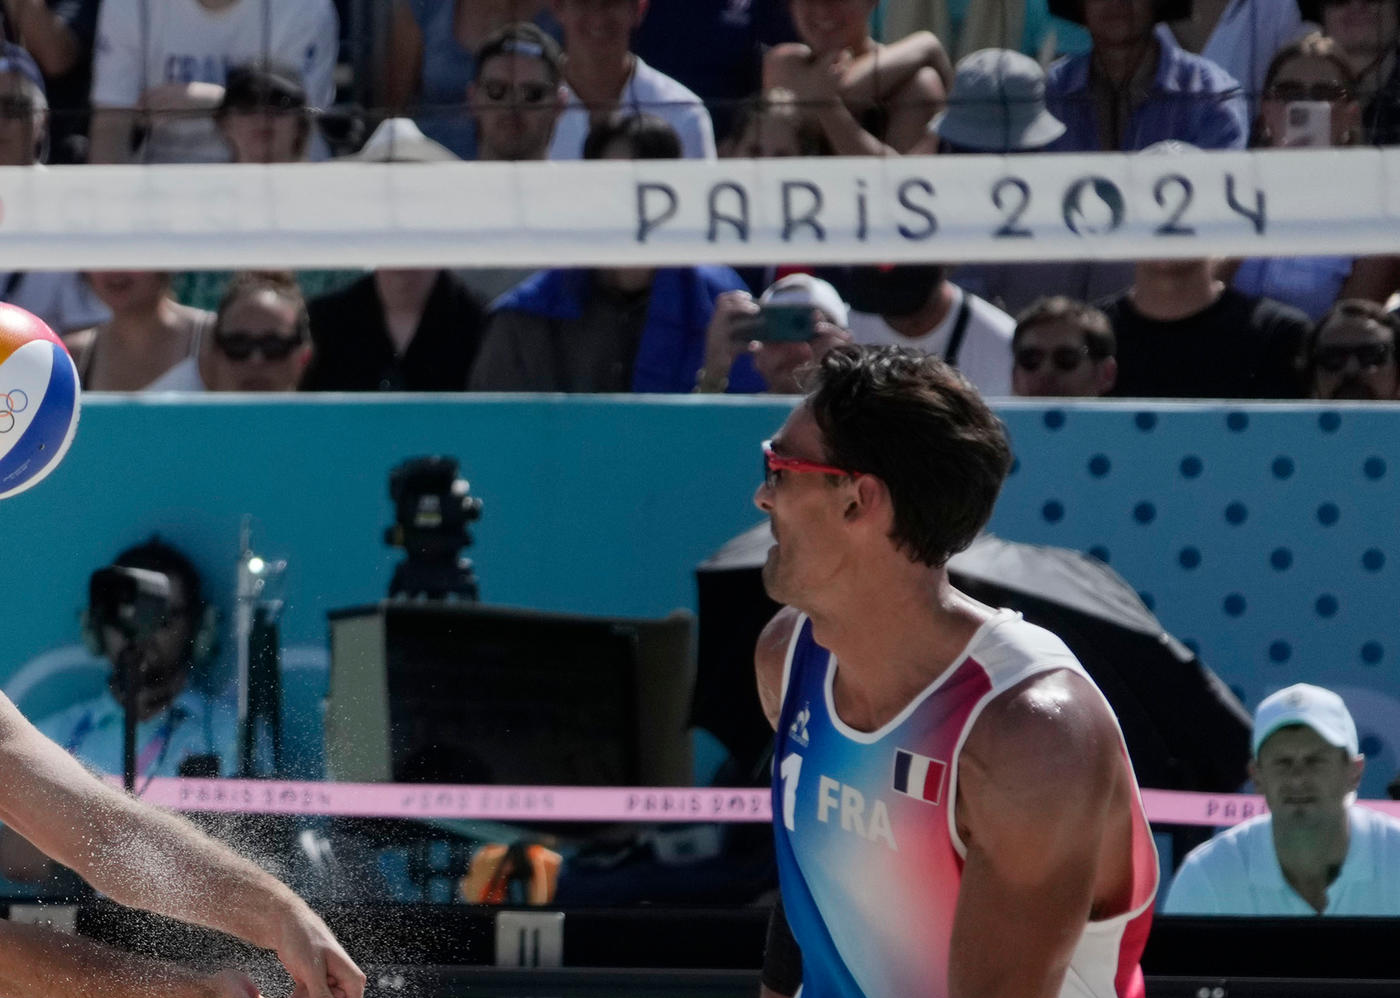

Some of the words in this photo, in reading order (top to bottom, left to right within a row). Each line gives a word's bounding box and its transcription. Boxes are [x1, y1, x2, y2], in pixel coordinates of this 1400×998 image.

[990, 172, 1268, 239] 2024
[780, 752, 803, 832] 1
[817, 774, 898, 852] FRA
